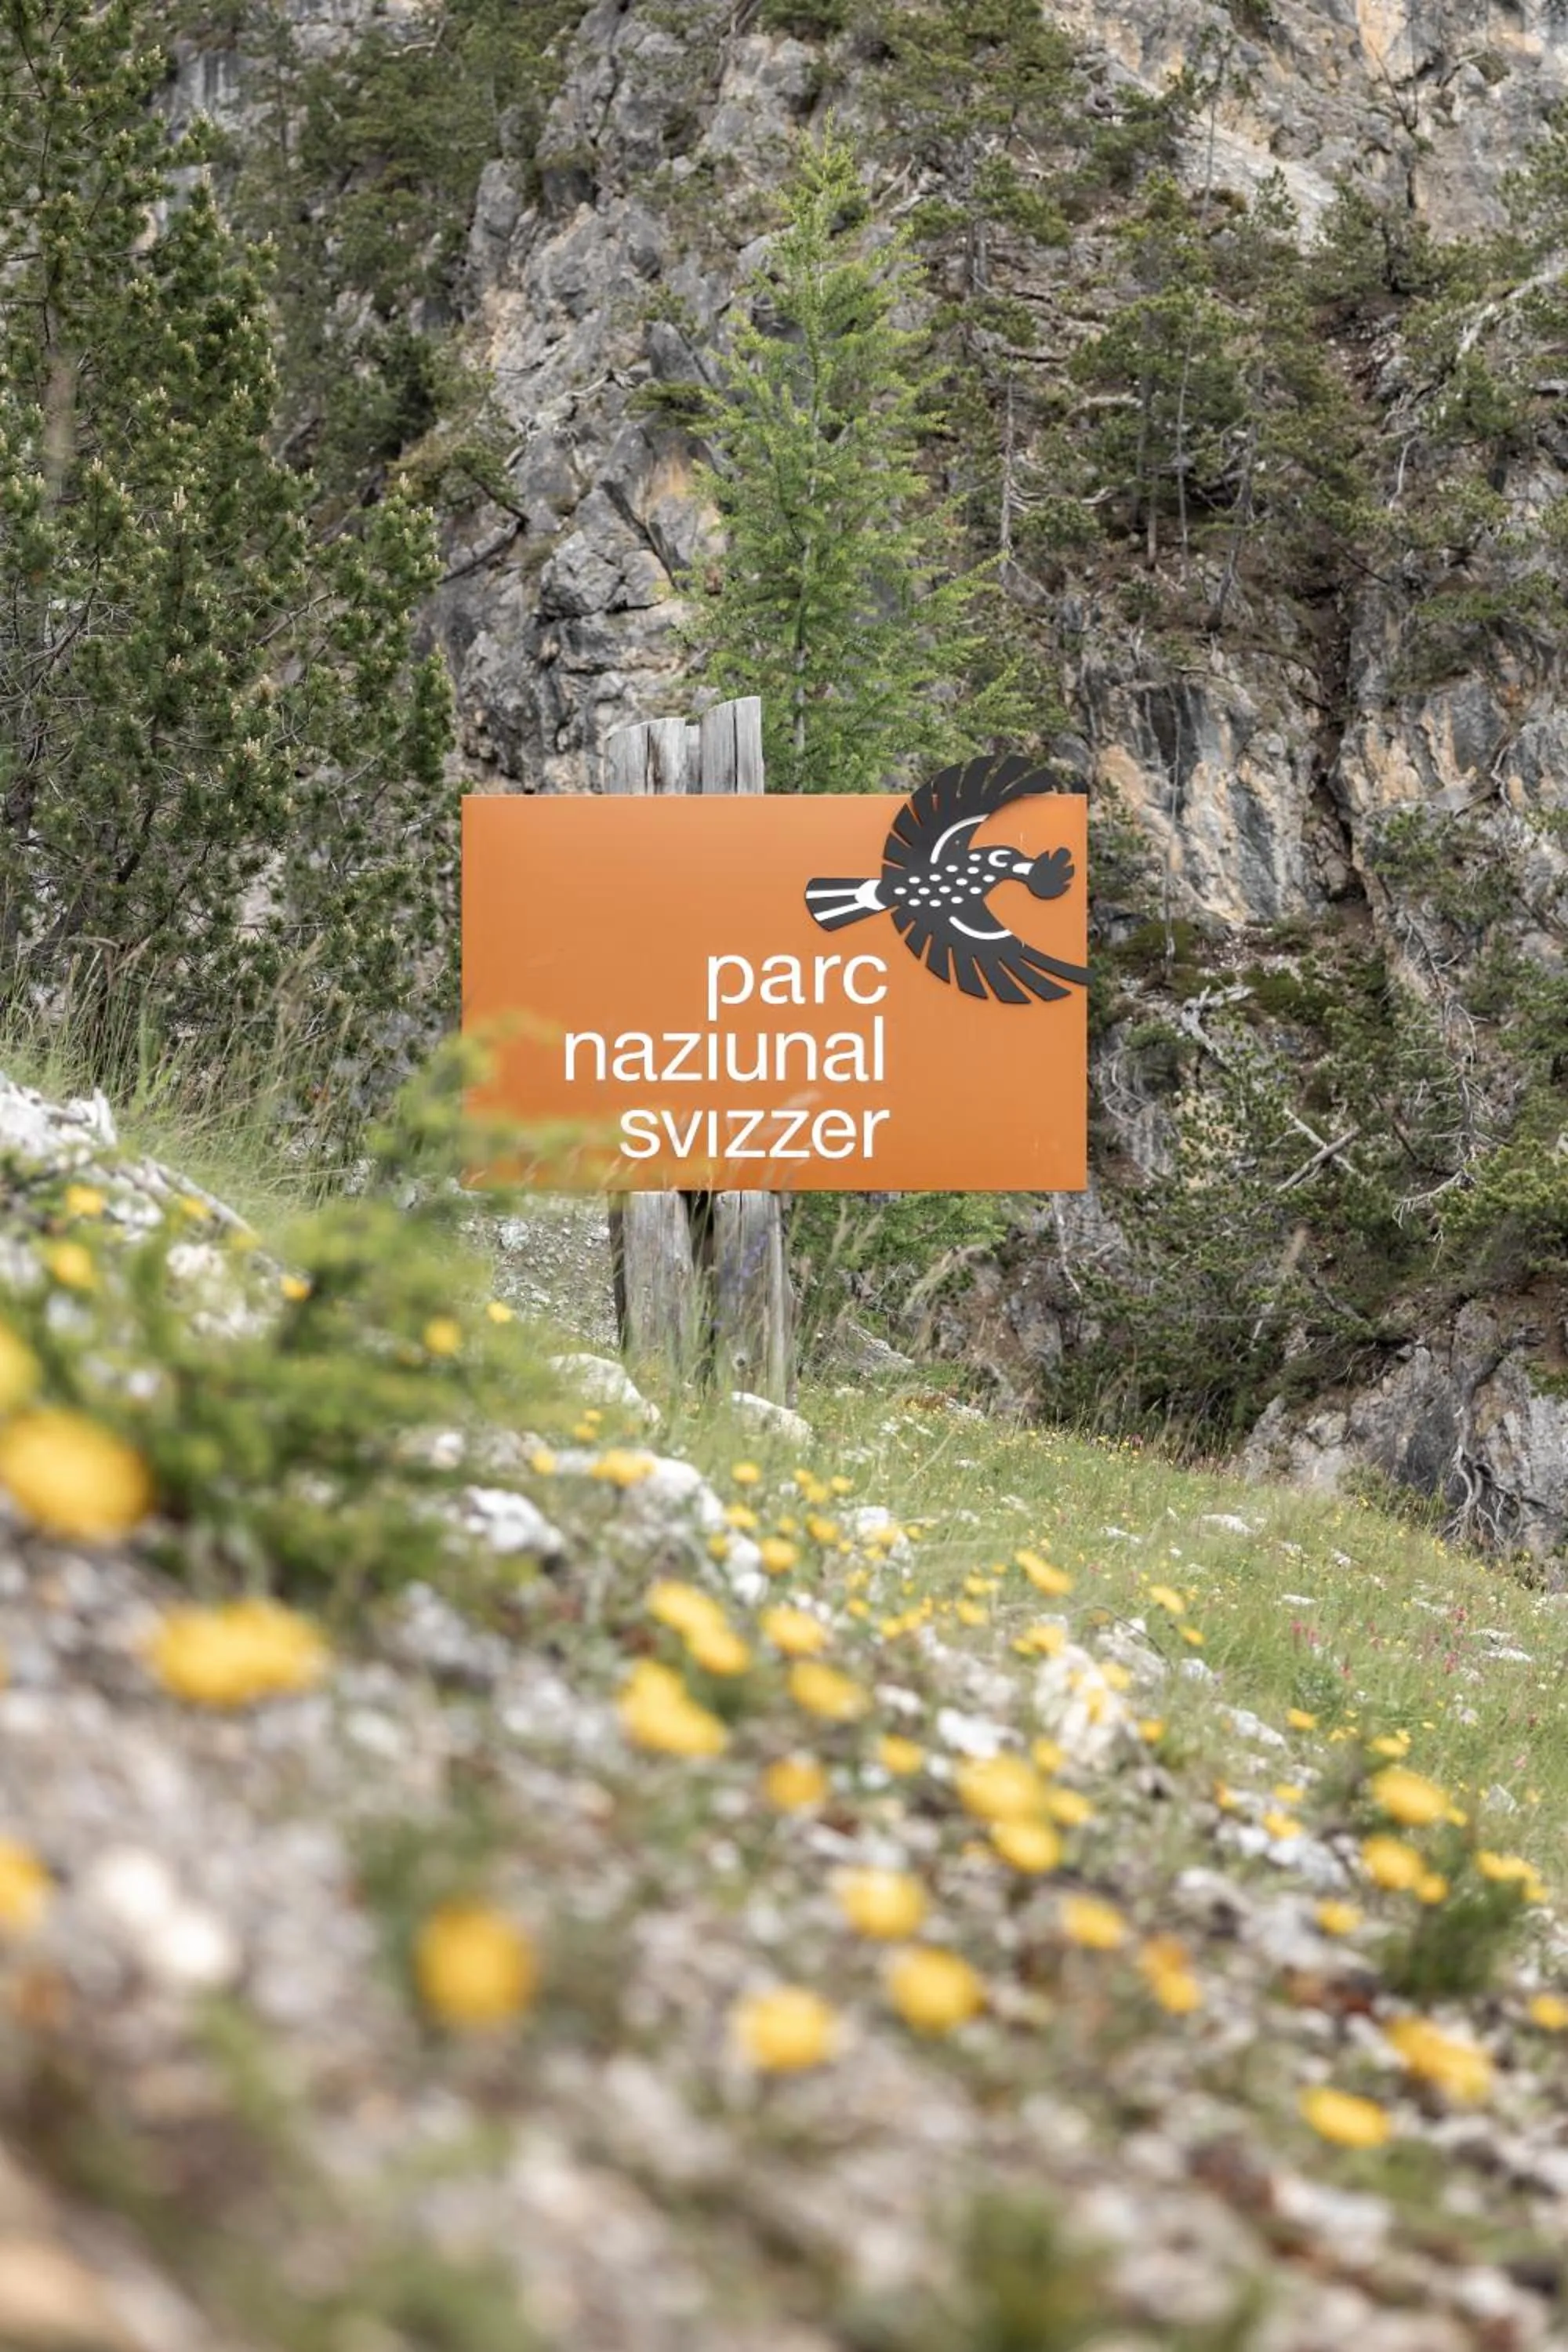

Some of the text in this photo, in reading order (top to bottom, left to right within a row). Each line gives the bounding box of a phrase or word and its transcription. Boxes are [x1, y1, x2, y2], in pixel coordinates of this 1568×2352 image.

[707, 954, 887, 1022] parc
[564, 1015, 884, 1082] naziunal
[619, 1109, 891, 1159] svizzer
